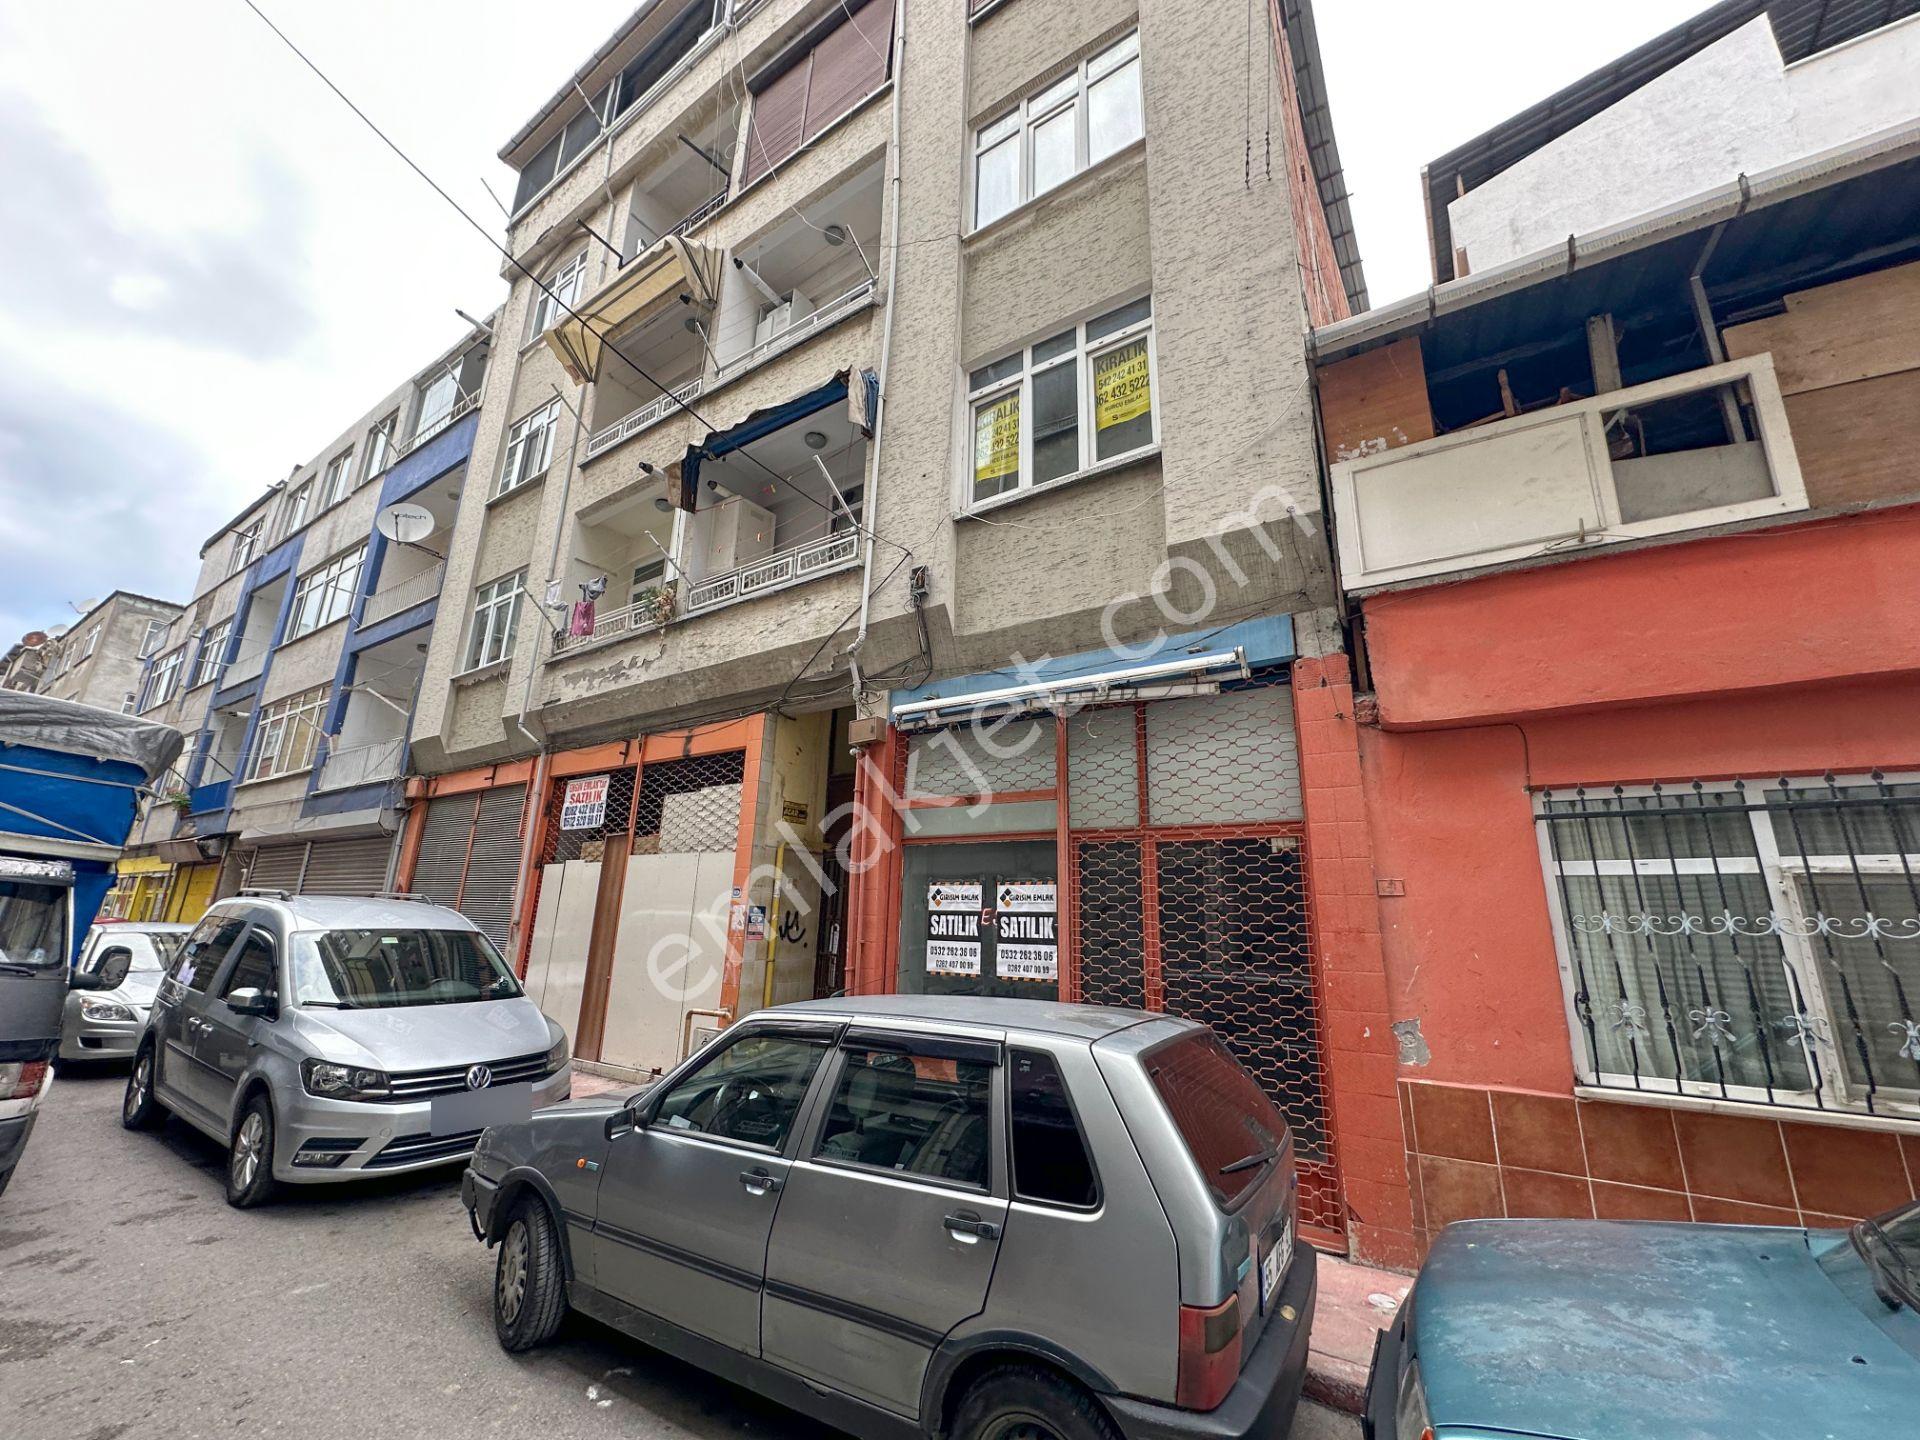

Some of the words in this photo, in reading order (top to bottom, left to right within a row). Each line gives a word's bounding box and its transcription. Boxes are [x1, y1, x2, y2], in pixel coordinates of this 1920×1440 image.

[1138, 359, 1147, 372] 31
[1111, 383, 1127, 399] 432
[570, 790, 602, 804] SATILIK
[930, 914, 979, 936] SATILIK
[1000, 916, 1054, 939] SATILIK
[930, 946, 945, 956] 0532
[947, 946, 958, 957] 262
[1000, 949, 1017, 960] 0532
[1020, 949, 1032, 961] 262
[1044, 951, 1053, 962] 06
